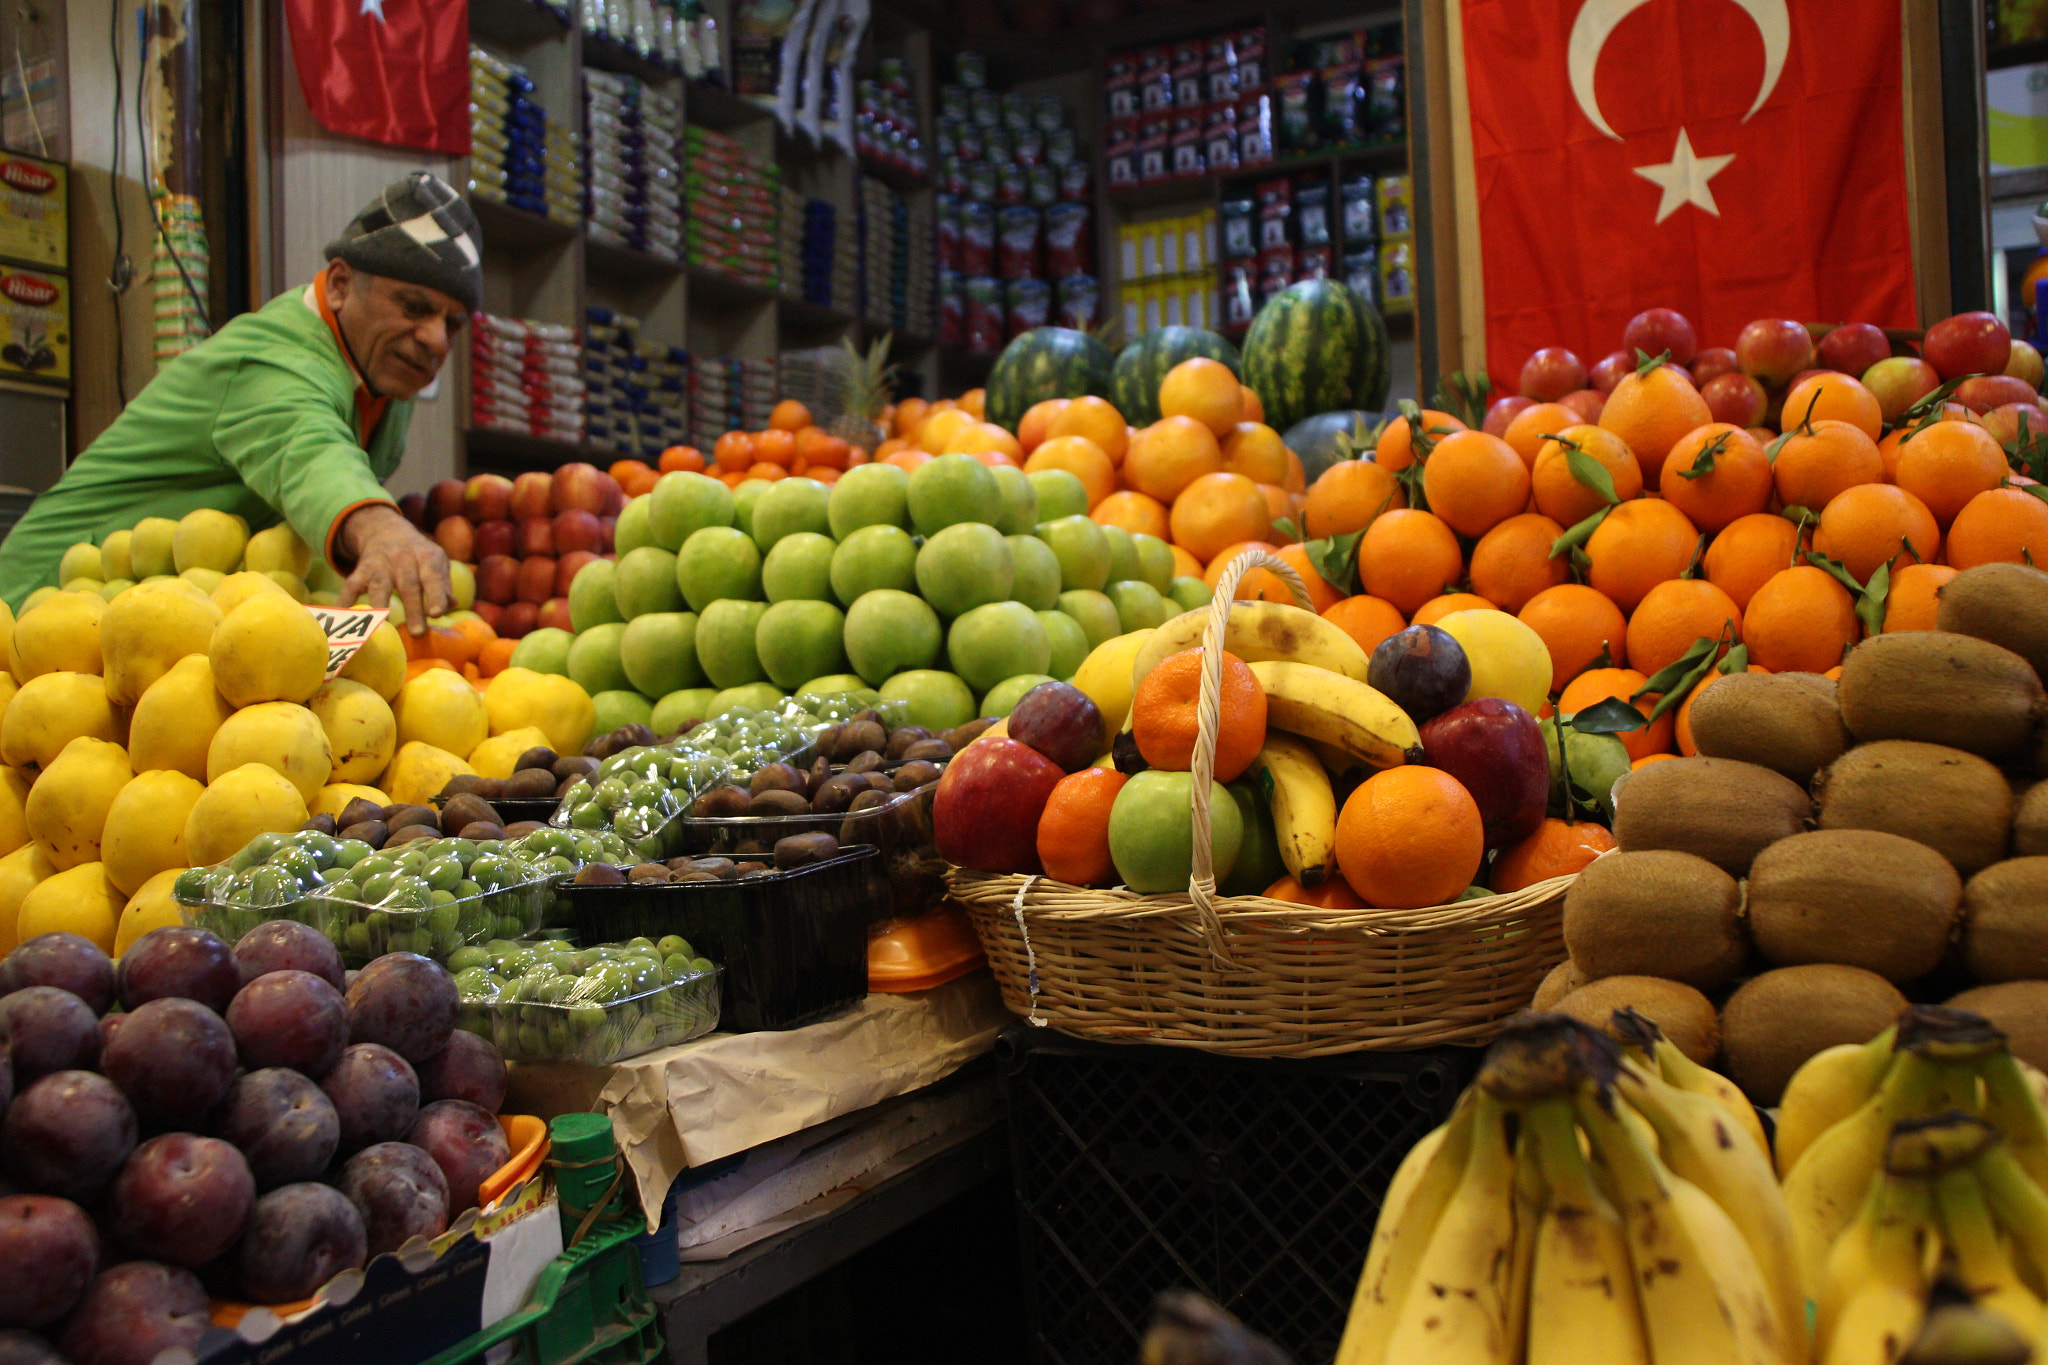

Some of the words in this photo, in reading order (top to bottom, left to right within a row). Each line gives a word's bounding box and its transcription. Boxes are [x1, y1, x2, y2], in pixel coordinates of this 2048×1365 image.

[5, 165, 52, 189] Hisar
[8, 279, 55, 301] Hisar
[316, 612, 374, 638] VA
